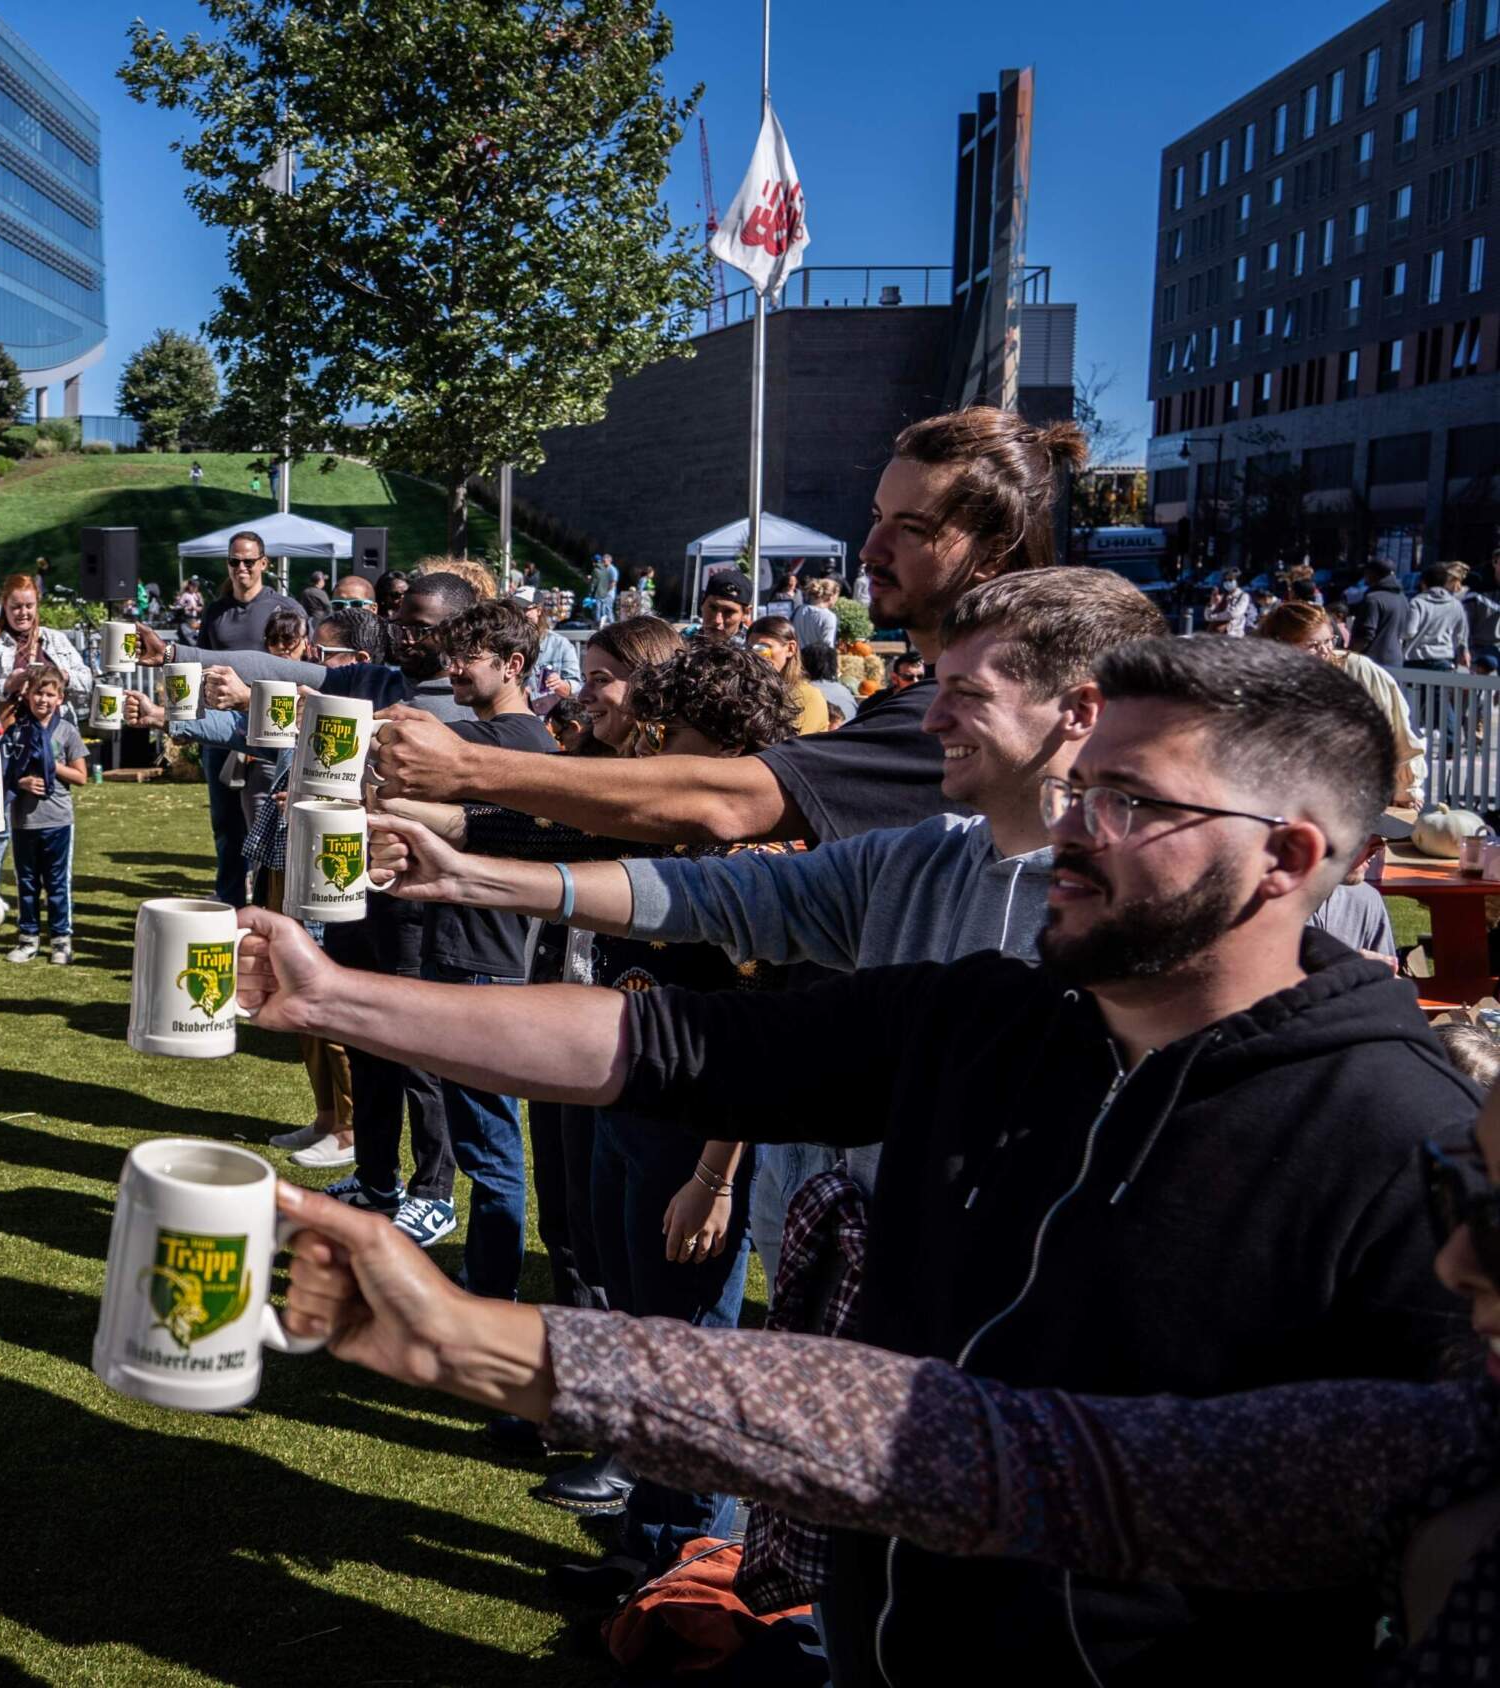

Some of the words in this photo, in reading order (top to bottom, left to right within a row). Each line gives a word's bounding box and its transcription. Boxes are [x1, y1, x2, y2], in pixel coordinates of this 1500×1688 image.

[1097, 537, 1156, 548] U-HAUL
[319, 720, 351, 739] Trapp
[342, 773, 357, 782] 2022
[326, 838, 360, 856] Trapp
[312, 893, 354, 903] Oktoberfest
[192, 949, 232, 972] Trapp
[172, 1020, 225, 1033] Oktoberfest
[159, 1237, 236, 1282] Trapp
[216, 1350, 247, 1371] 2022
